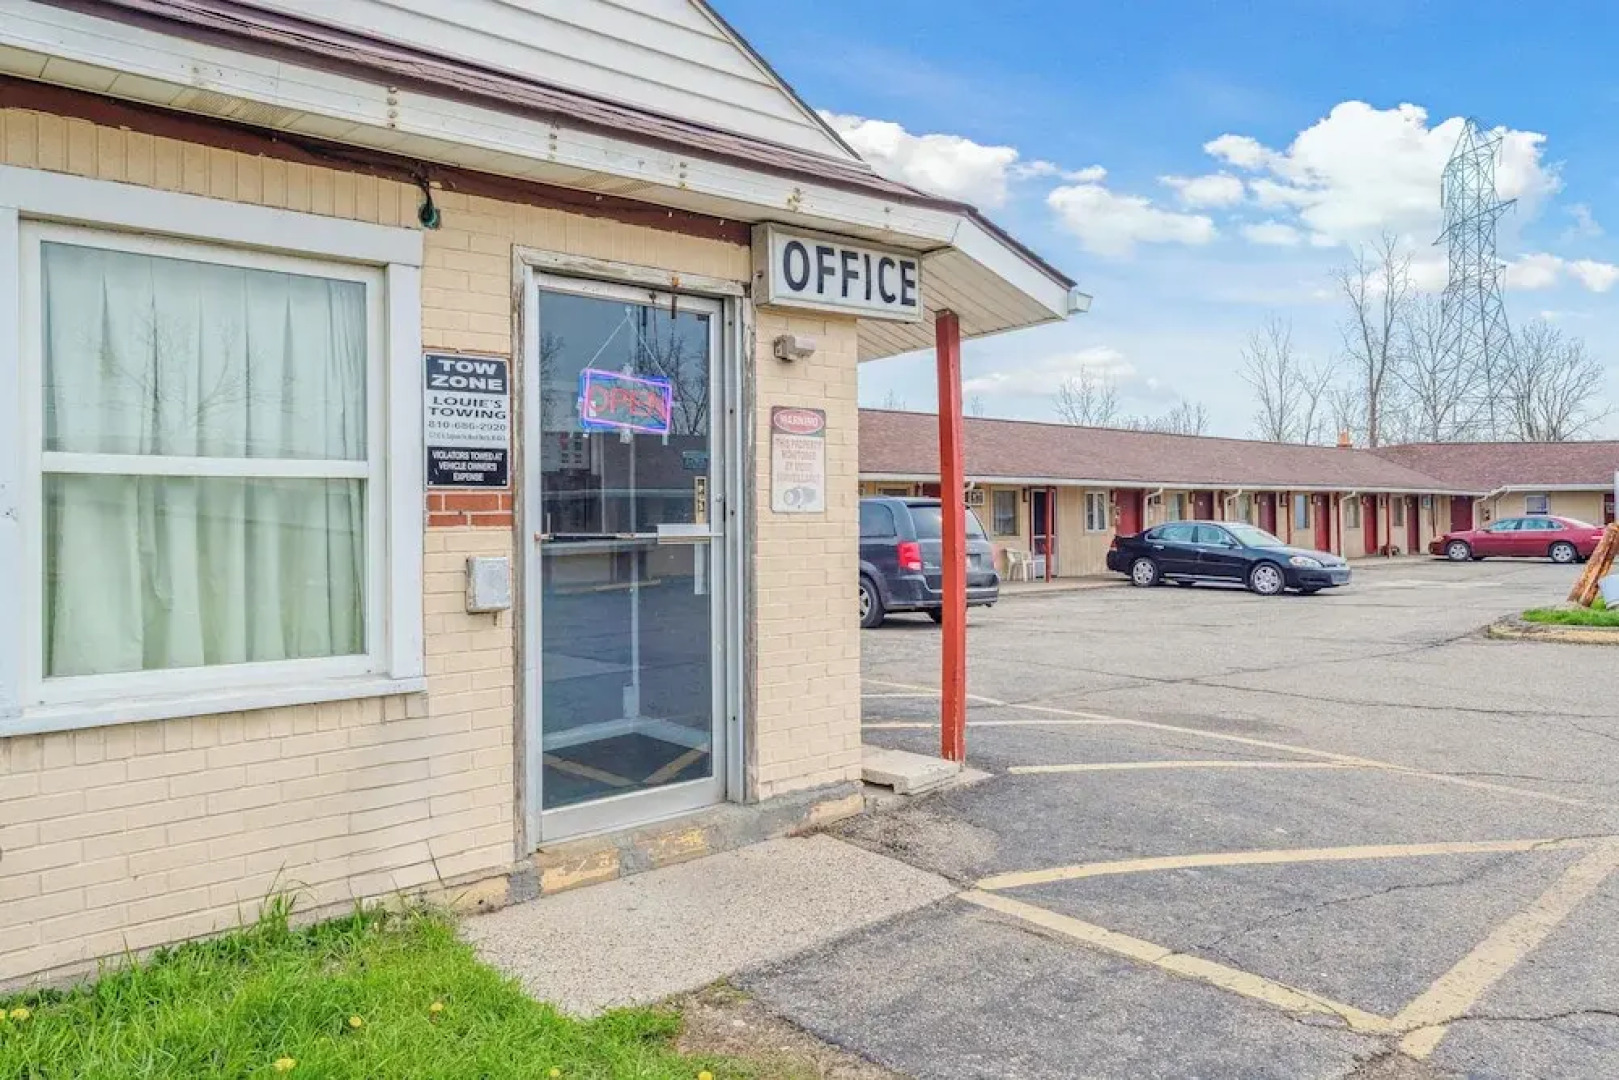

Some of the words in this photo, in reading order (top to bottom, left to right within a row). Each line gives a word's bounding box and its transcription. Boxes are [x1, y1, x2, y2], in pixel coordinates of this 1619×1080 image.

[783, 240, 916, 307] OFFICE
[438, 359, 498, 375] TOW
[431, 373, 503, 391] ZONE
[433, 396, 503, 409] LOUIE'S
[588, 384, 668, 421] OPEN
[428, 405, 506, 419] TOWING
[780, 414, 819, 427] WARNING
